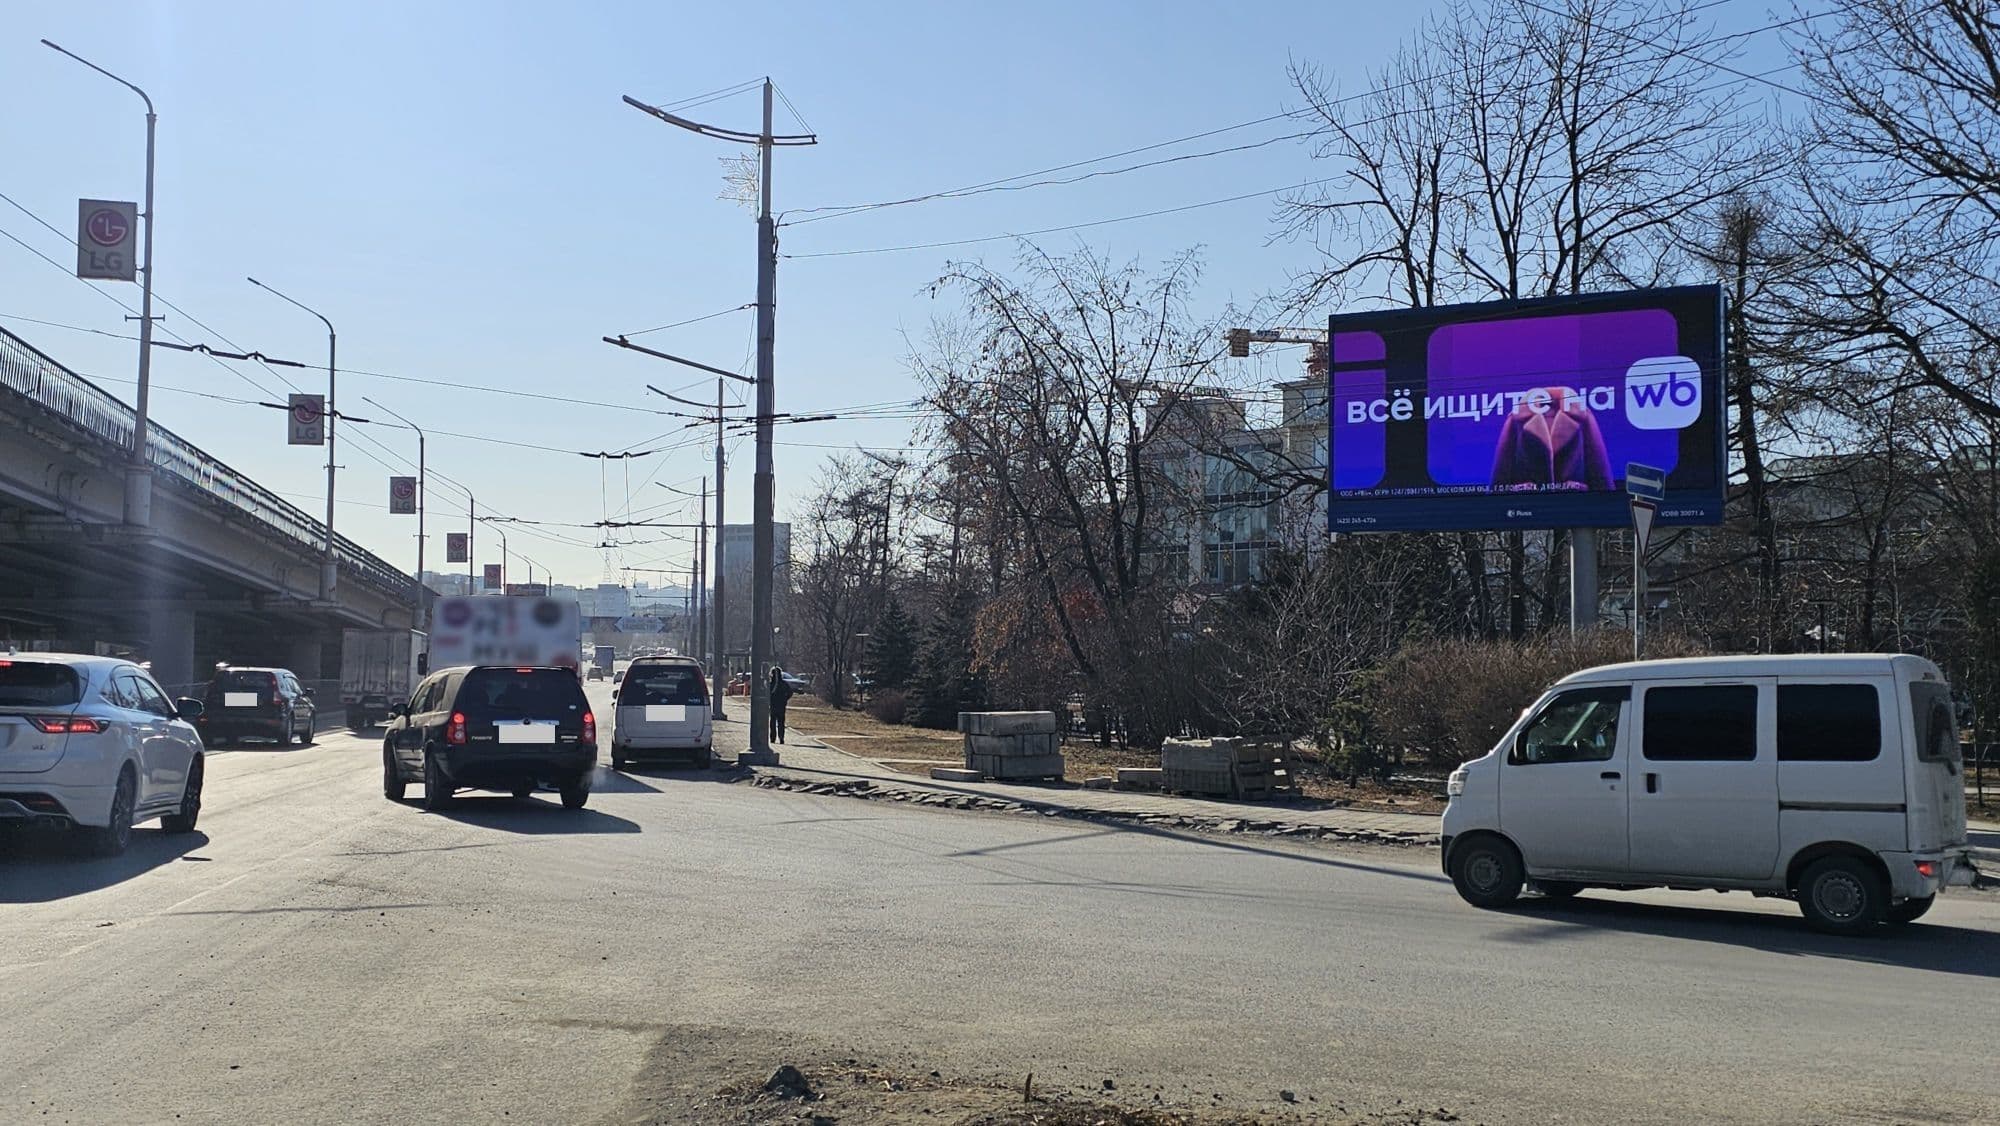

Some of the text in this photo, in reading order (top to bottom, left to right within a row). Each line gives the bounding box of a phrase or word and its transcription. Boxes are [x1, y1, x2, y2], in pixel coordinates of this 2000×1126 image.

[90, 251, 122, 270] LG
[1630, 371, 1697, 408] wb
[1347, 386, 1615, 423] всё ищите на
[296, 427, 317, 439] LG
